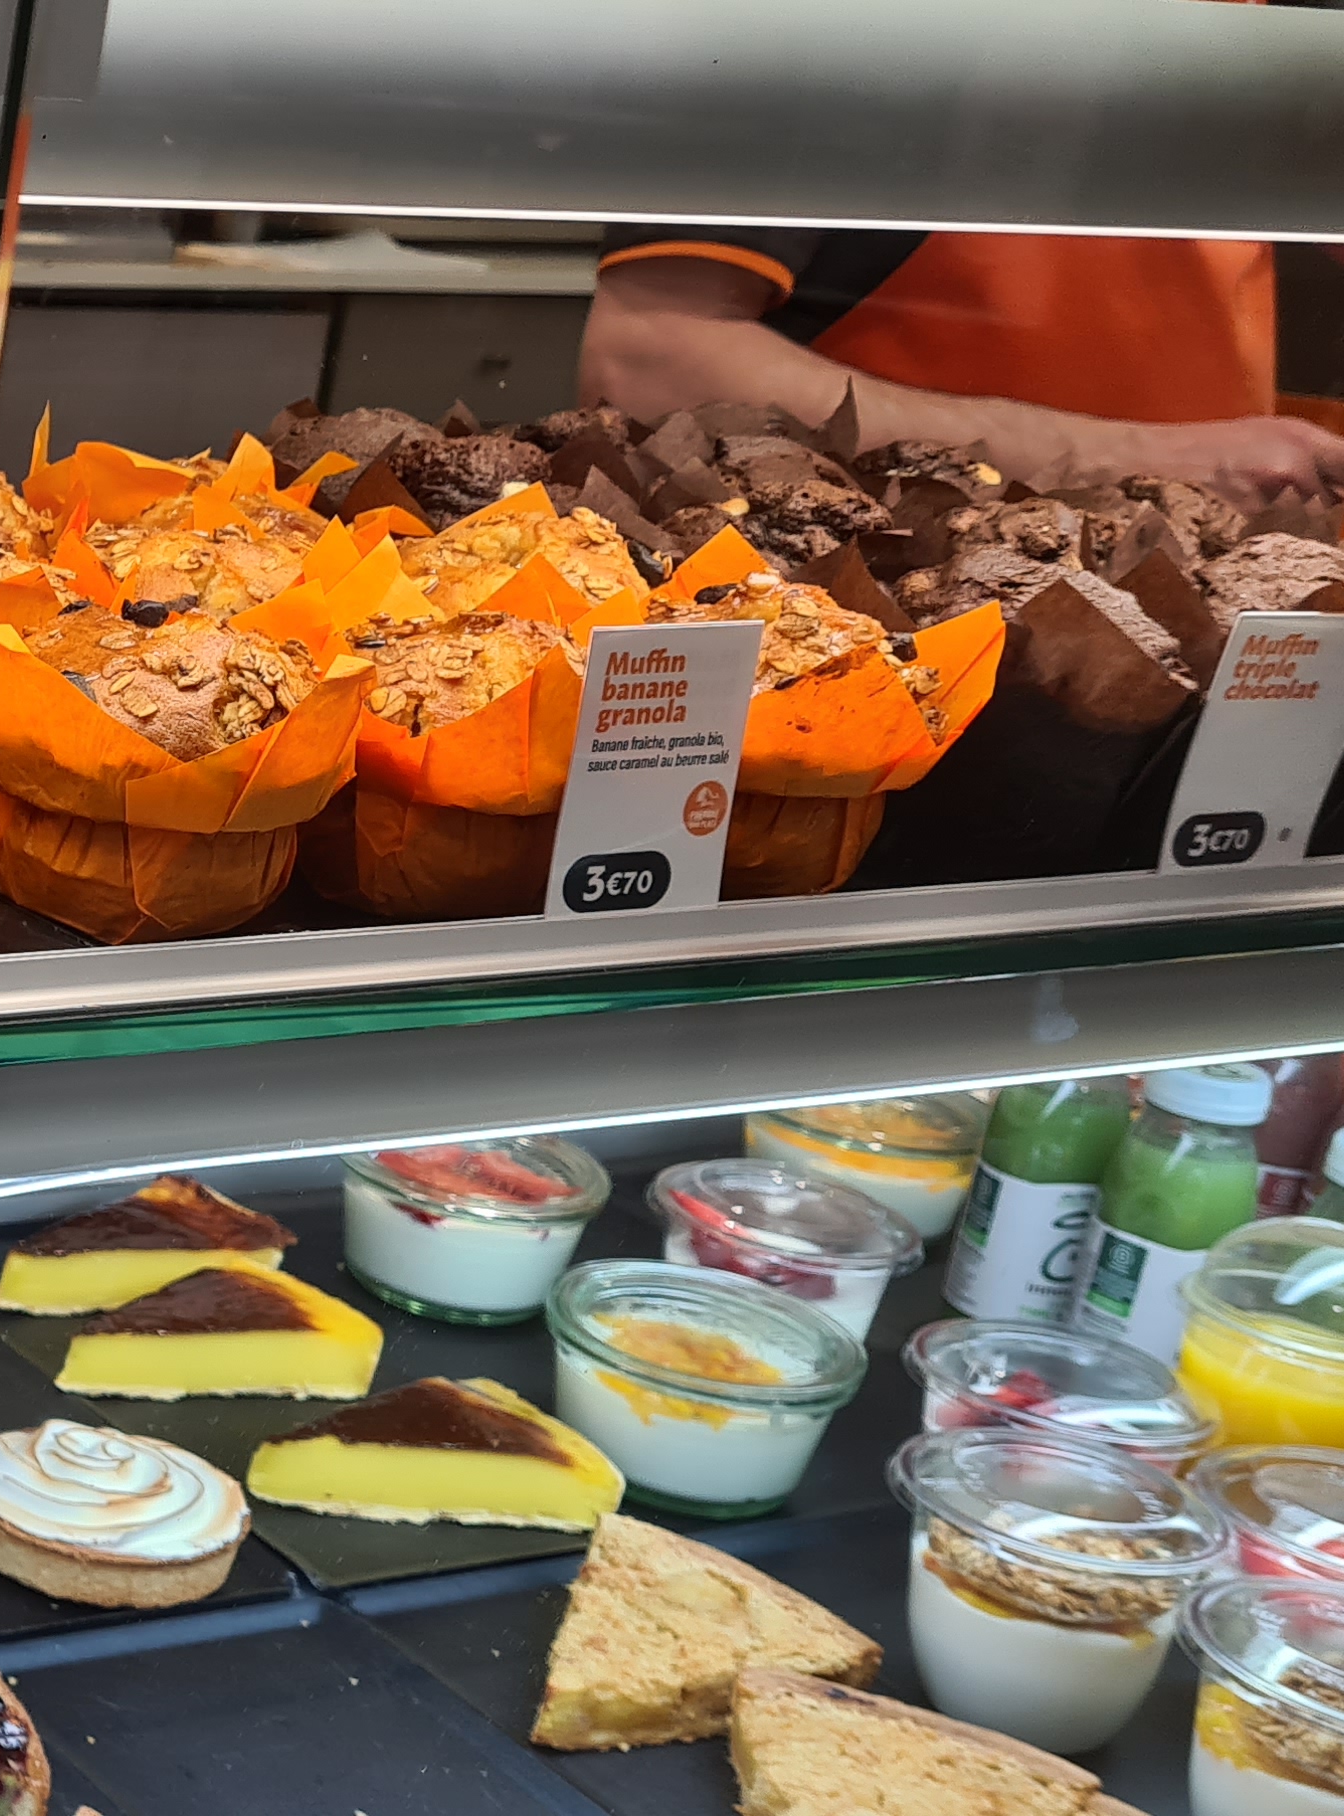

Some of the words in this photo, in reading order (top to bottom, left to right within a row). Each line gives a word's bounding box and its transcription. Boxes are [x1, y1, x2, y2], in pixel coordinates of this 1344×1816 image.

[605, 647, 686, 677] Muffin
[601, 676, 689, 702] banane
[595, 699, 687, 733] granola
[591, 738, 629, 753] Banane
[667, 732, 706, 751] granola
[587, 759, 618, 772] sauce
[619, 754, 660, 770] caramel
[660, 756, 673, 768] au
[675, 753, 707, 767] beurre
[708, 749, 730, 764] salé
[582, 865, 653, 902] 3€70
